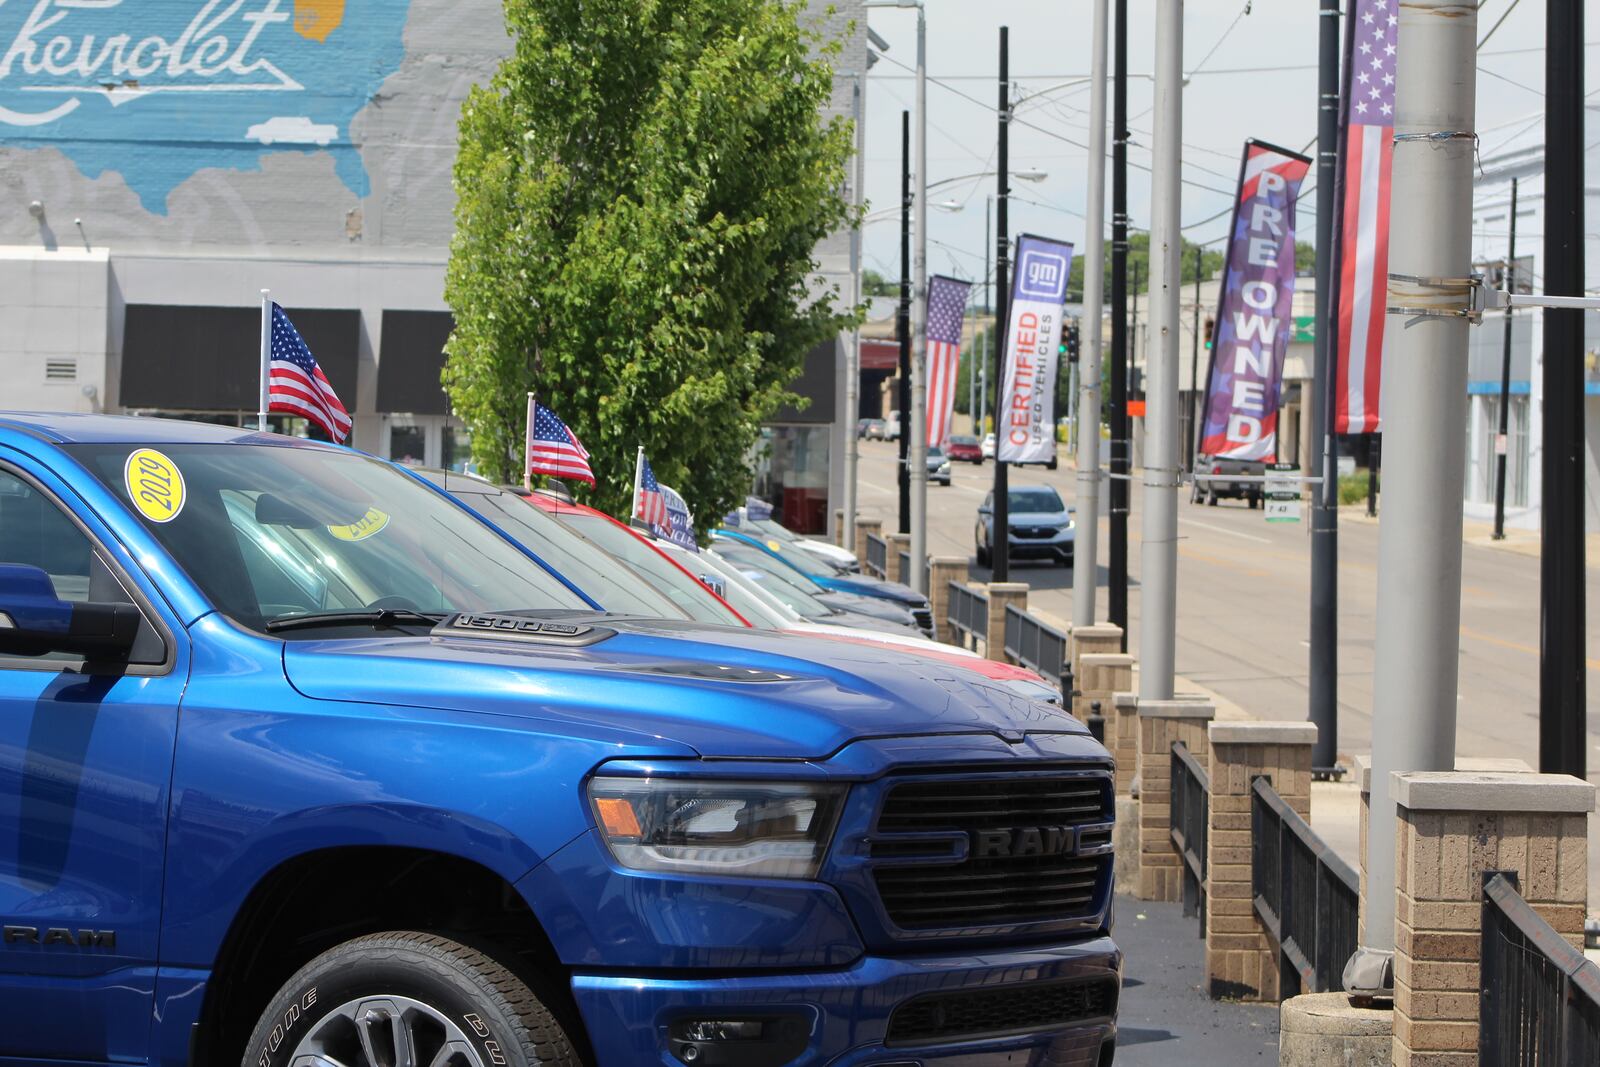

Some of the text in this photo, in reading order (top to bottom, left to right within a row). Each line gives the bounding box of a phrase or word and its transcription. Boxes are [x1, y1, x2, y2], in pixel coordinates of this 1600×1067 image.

[1028, 261, 1058, 287] gm
[1009, 312, 1038, 446] CERTIFIED
[1032, 314, 1052, 445] USED VEHICLES
[1226, 281, 1280, 443] OWNED
[138, 456, 172, 511] 2019
[460, 614, 542, 632] 1500
[976, 826, 1076, 857] RAM
[3, 924, 116, 948] RAM
